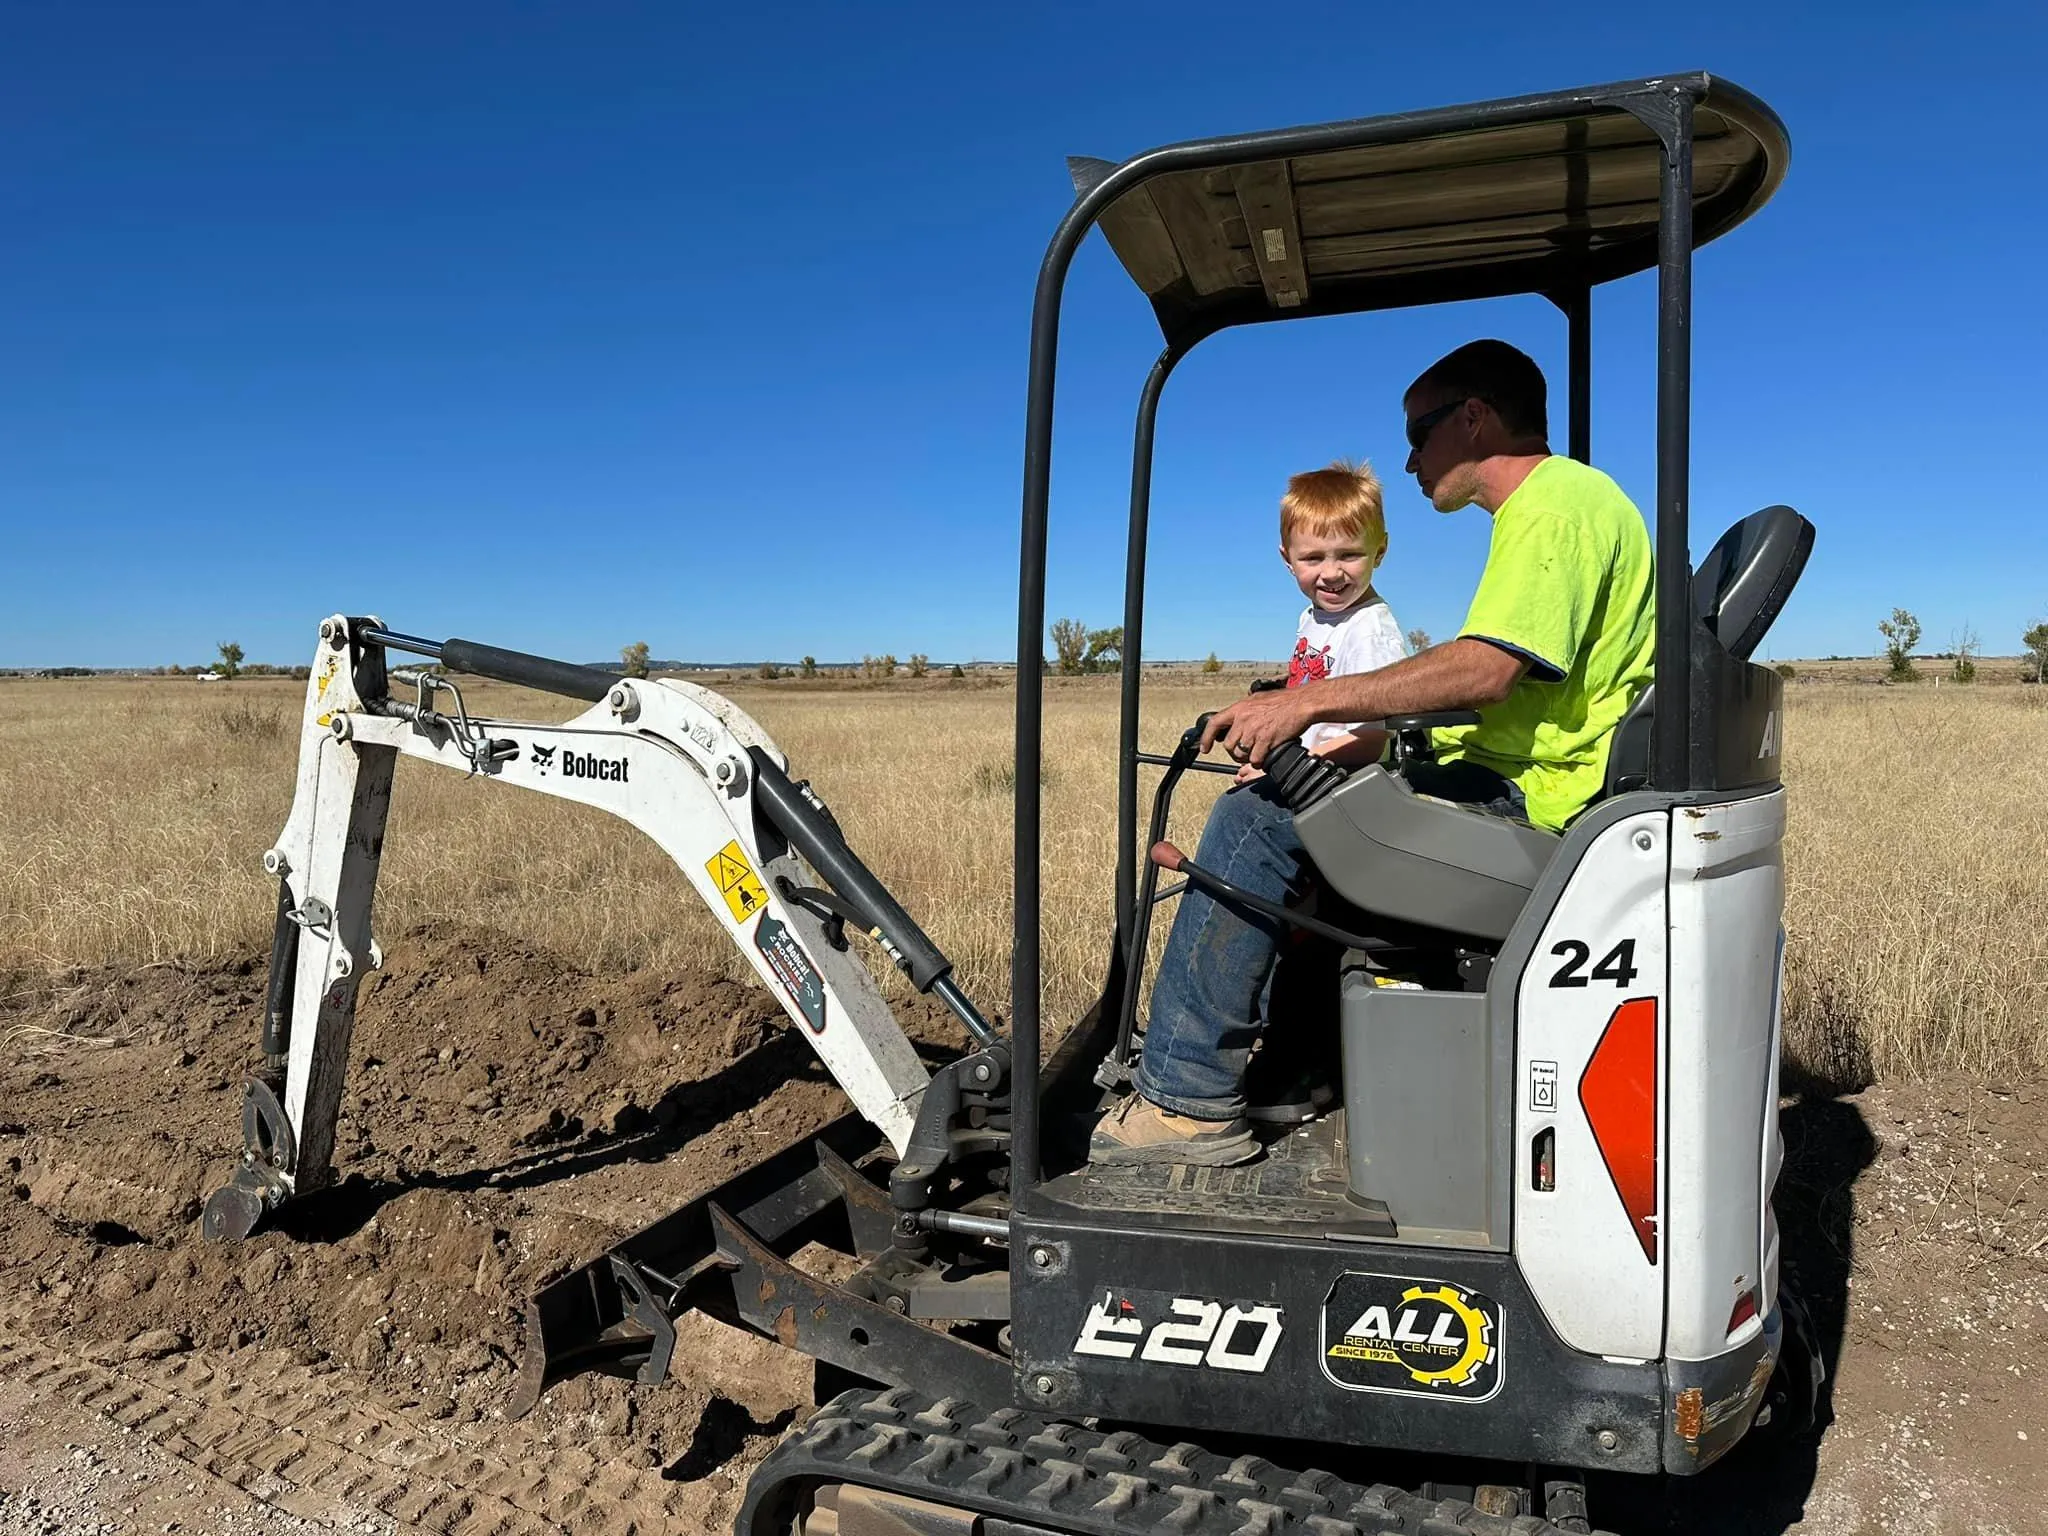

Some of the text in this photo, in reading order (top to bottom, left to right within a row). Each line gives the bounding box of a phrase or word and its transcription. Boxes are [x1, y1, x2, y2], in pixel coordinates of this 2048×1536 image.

[563, 750, 629, 783] Bobcat
[786, 943, 810, 978] Bobcat
[1549, 938, 1638, 988] 24
[1073, 1291, 1284, 1373] E20
[1345, 1305, 1464, 1347] ALL
[1336, 1347, 1394, 1360] SINCE 1976
[1344, 1336, 1459, 1357] RENTAL CENTER
